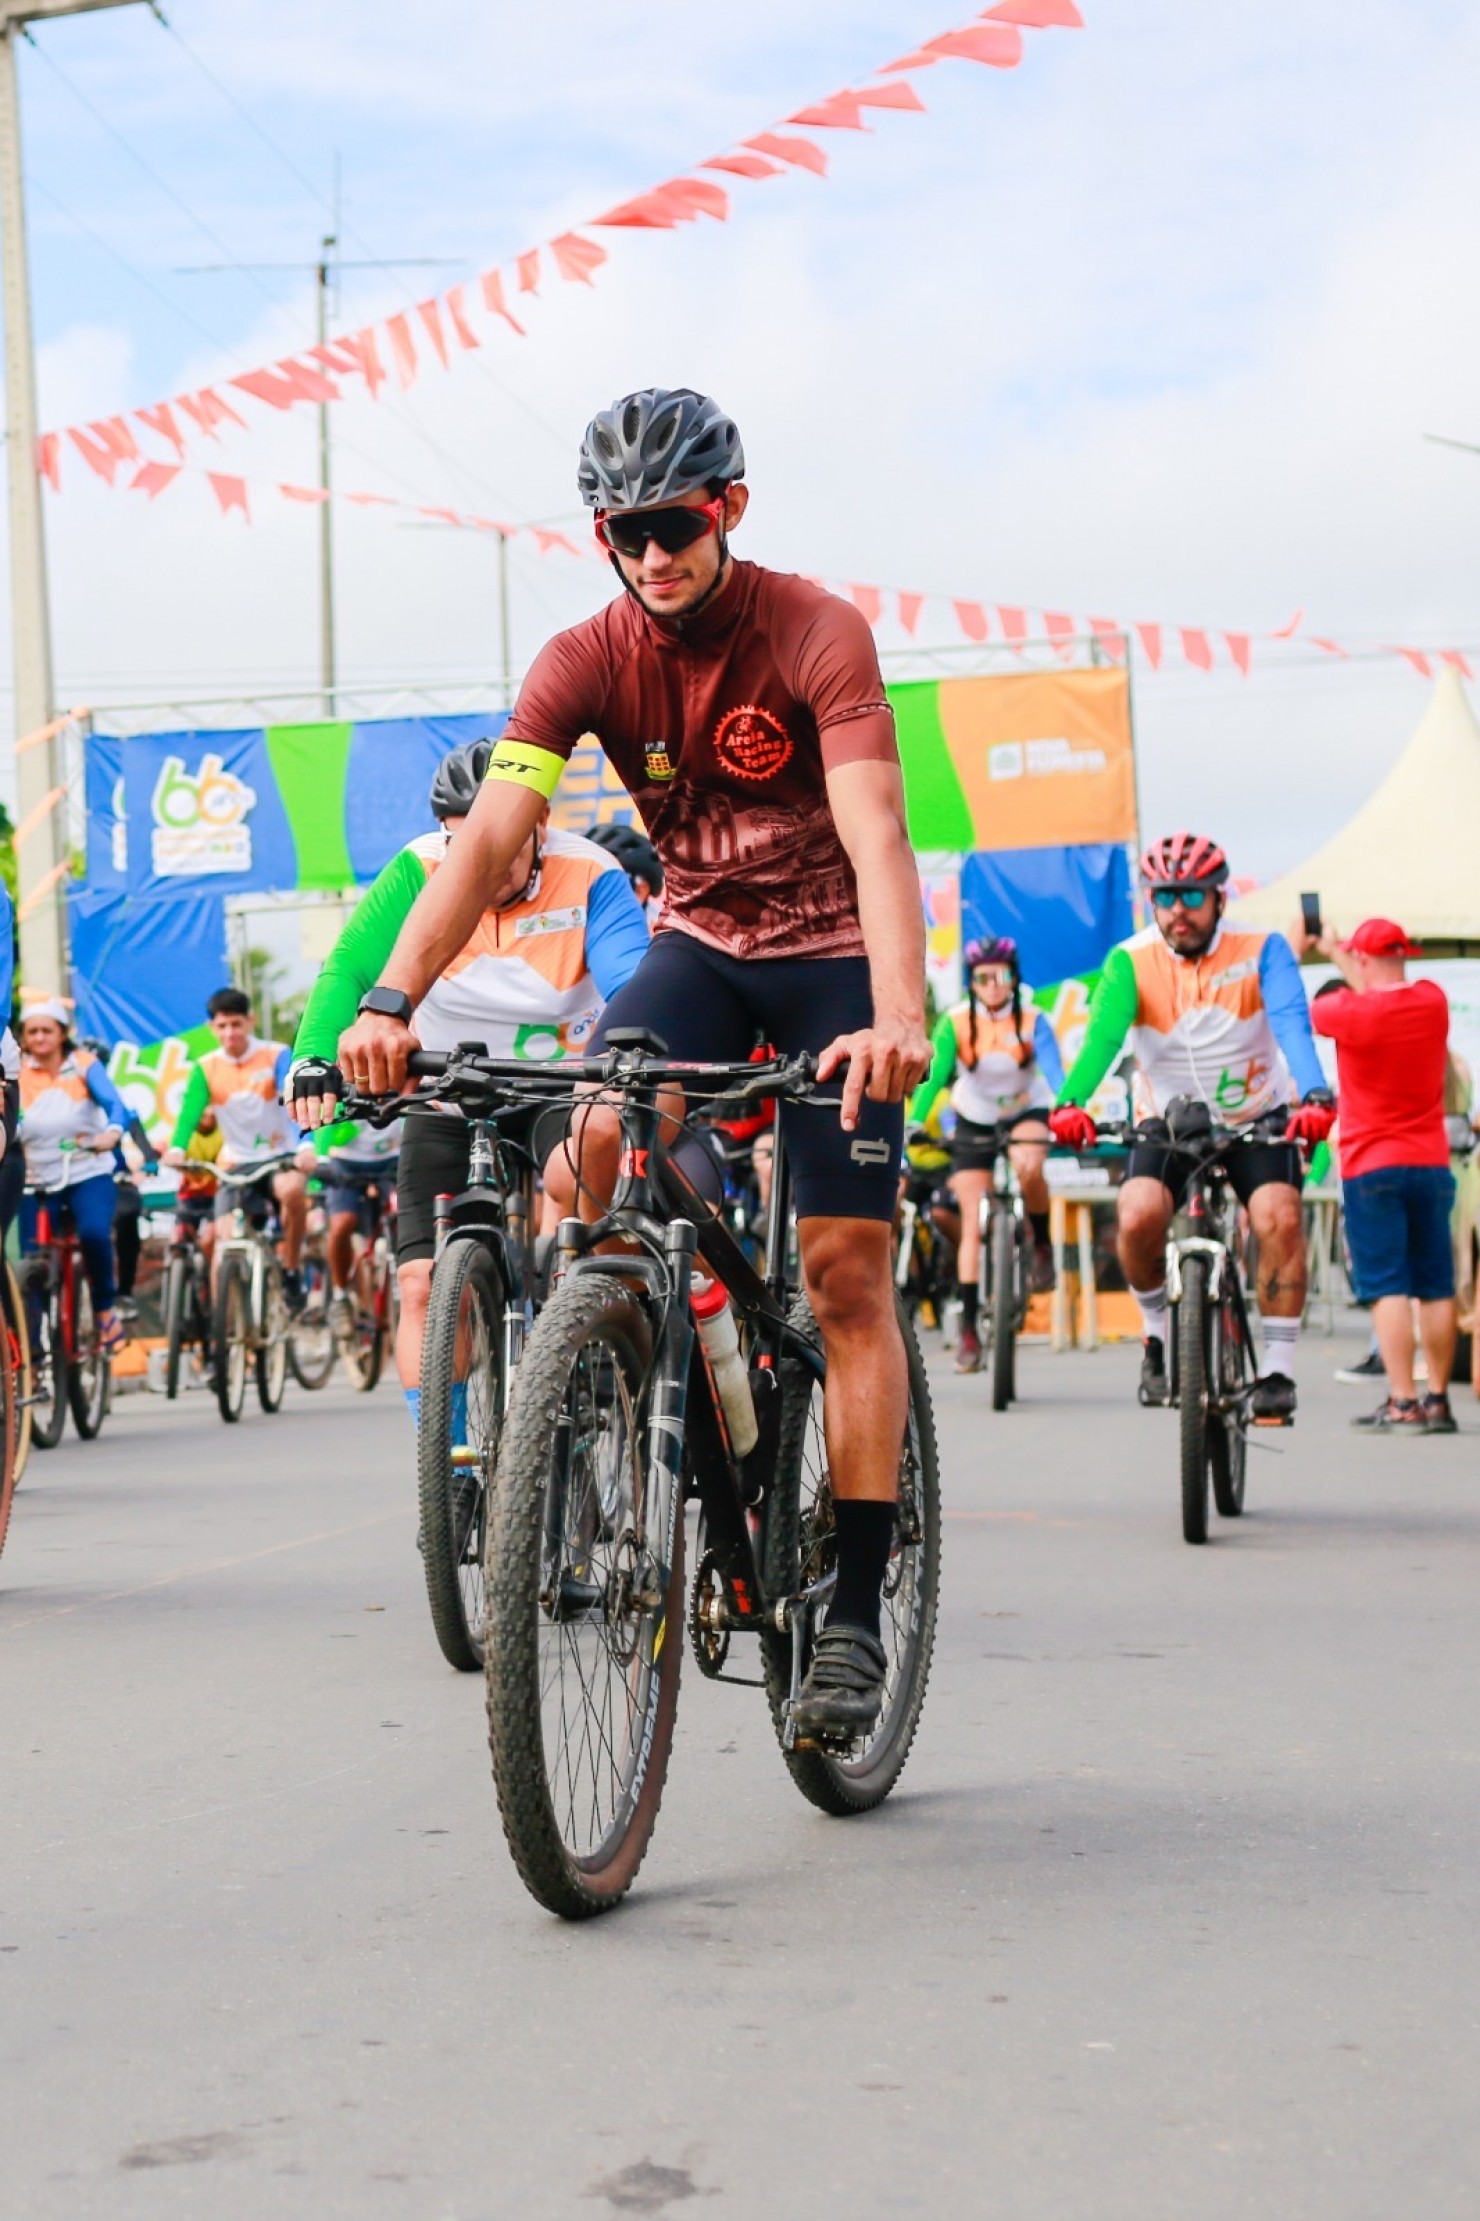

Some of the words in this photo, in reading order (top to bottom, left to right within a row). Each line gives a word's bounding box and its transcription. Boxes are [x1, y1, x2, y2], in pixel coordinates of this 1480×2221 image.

[733, 740, 782, 757] Racing
[742, 752, 781, 768] Team
[629, 1673, 661, 1801] EXTREME
